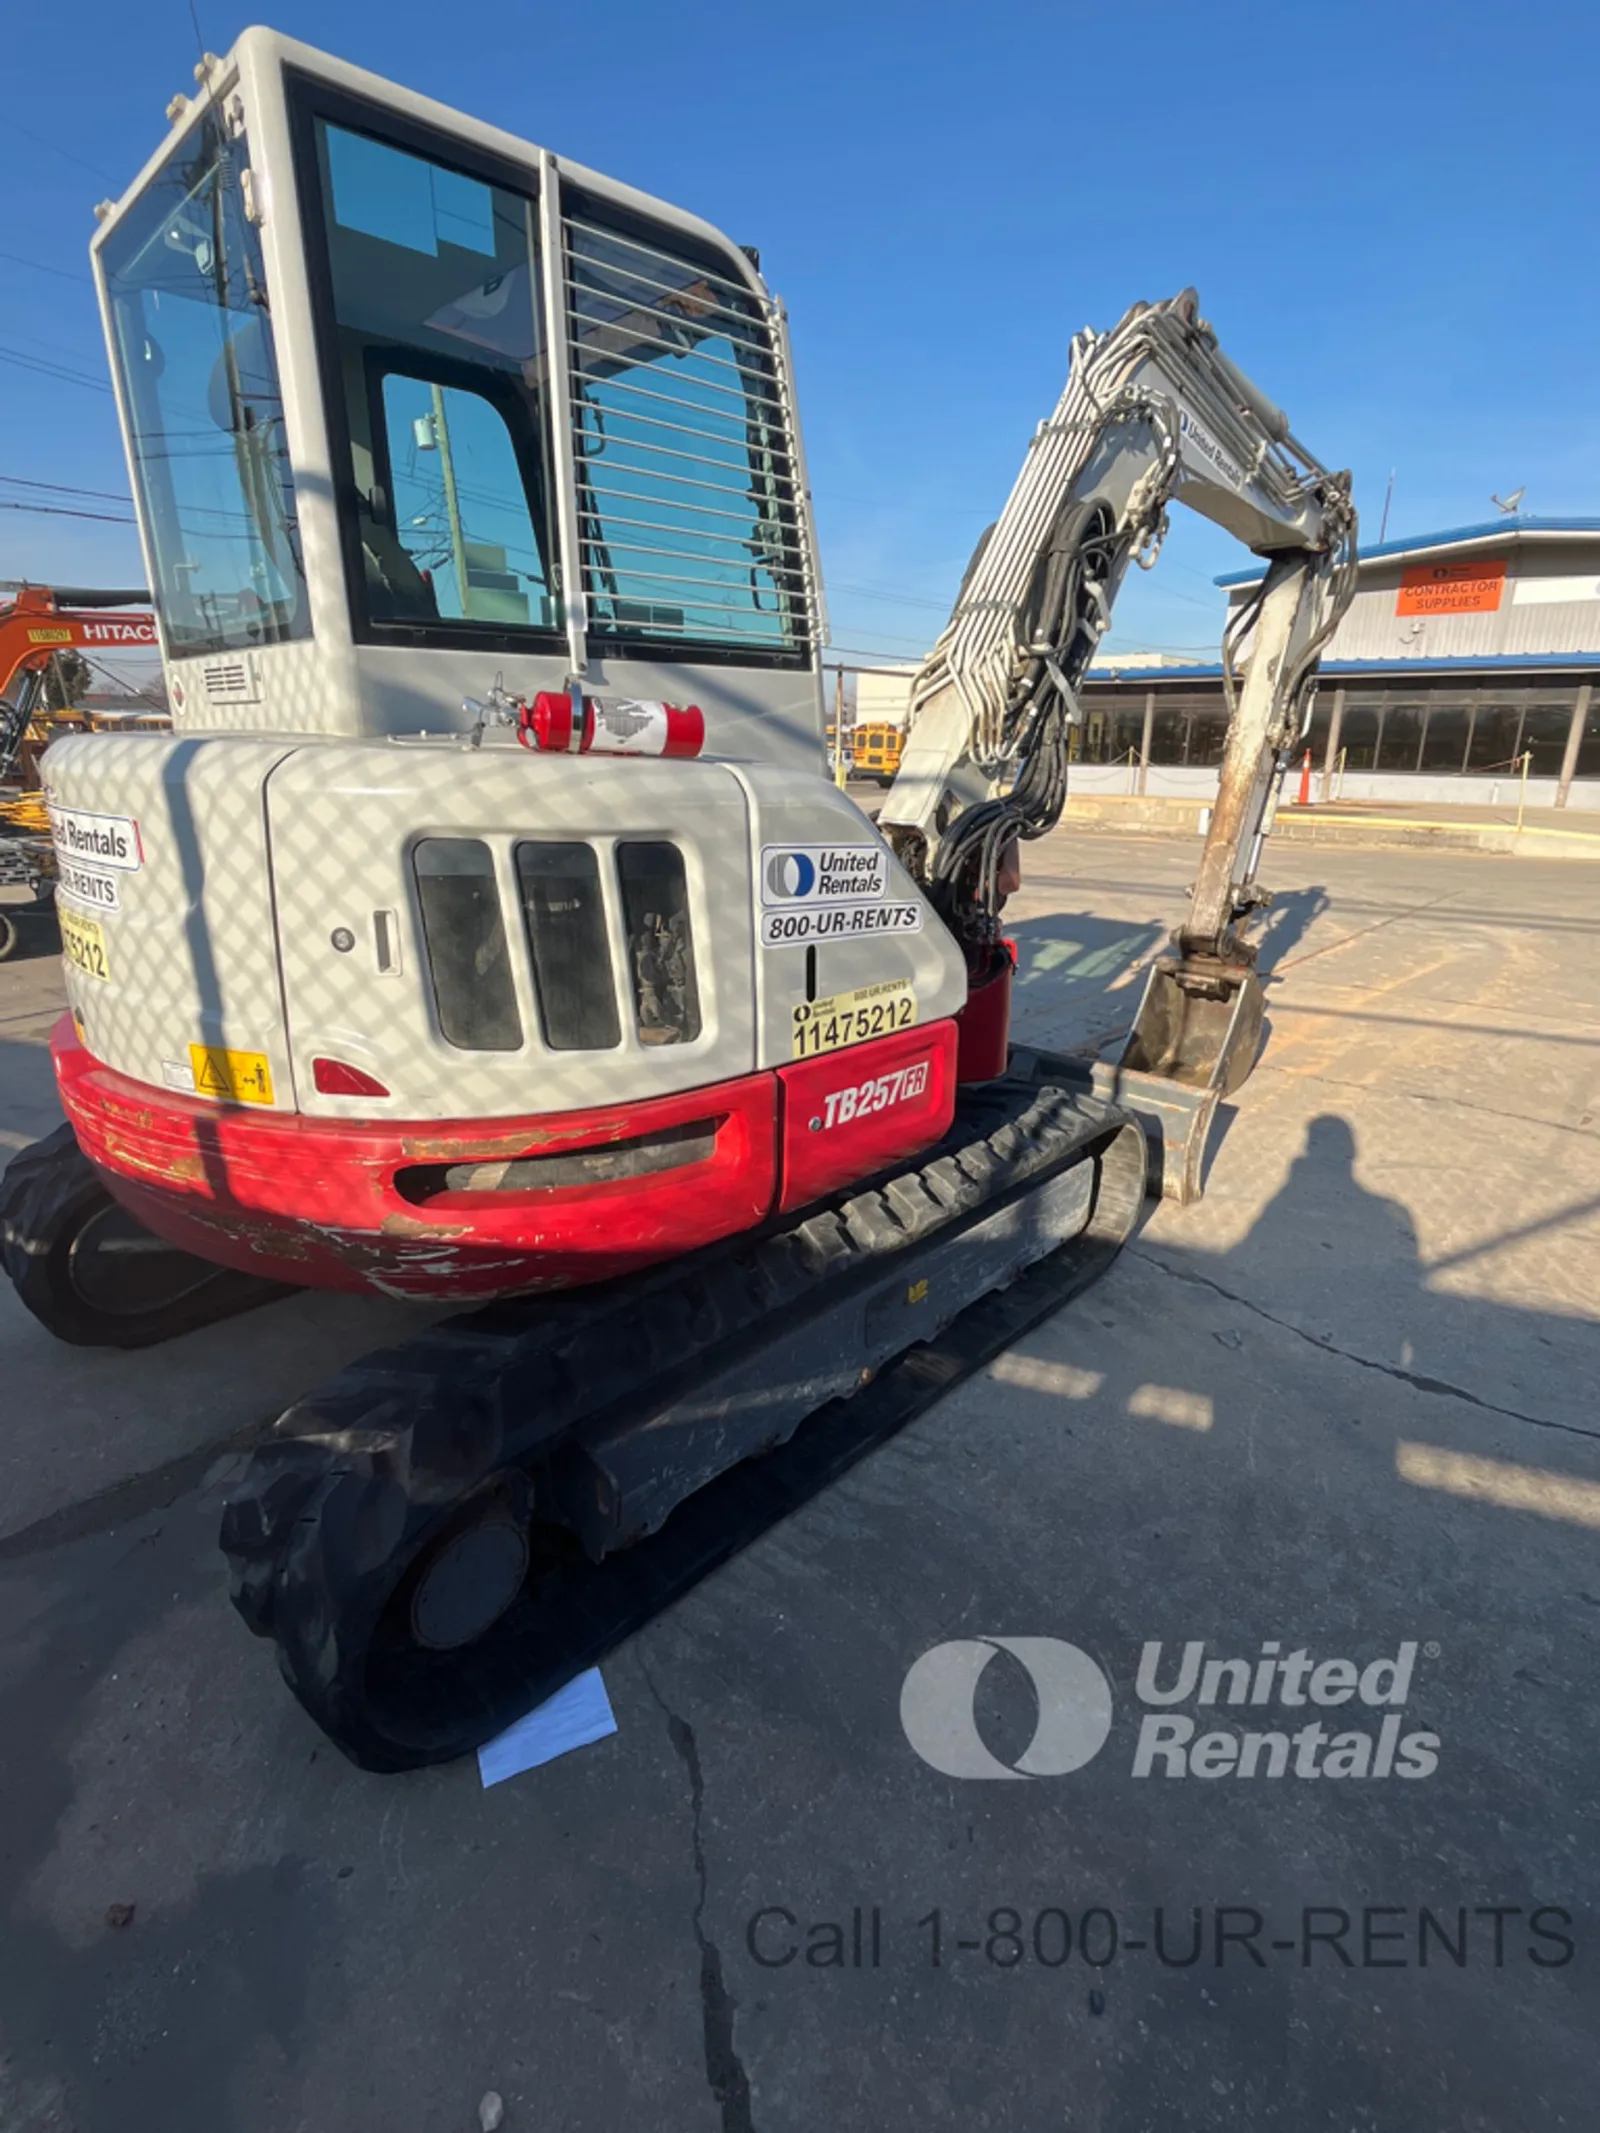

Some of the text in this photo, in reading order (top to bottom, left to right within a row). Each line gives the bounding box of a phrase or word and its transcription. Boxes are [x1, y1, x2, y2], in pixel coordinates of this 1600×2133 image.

[1405, 581, 1497, 597] CONTRACTOR
[1416, 596, 1481, 609] SUPPLIES
[67, 819, 127, 858] Rentals
[820, 852, 879, 872] United
[818, 874, 882, 895] Rentals
[769, 906, 917, 939] 800-UR-RENTS
[794, 997, 912, 1055] 11475212
